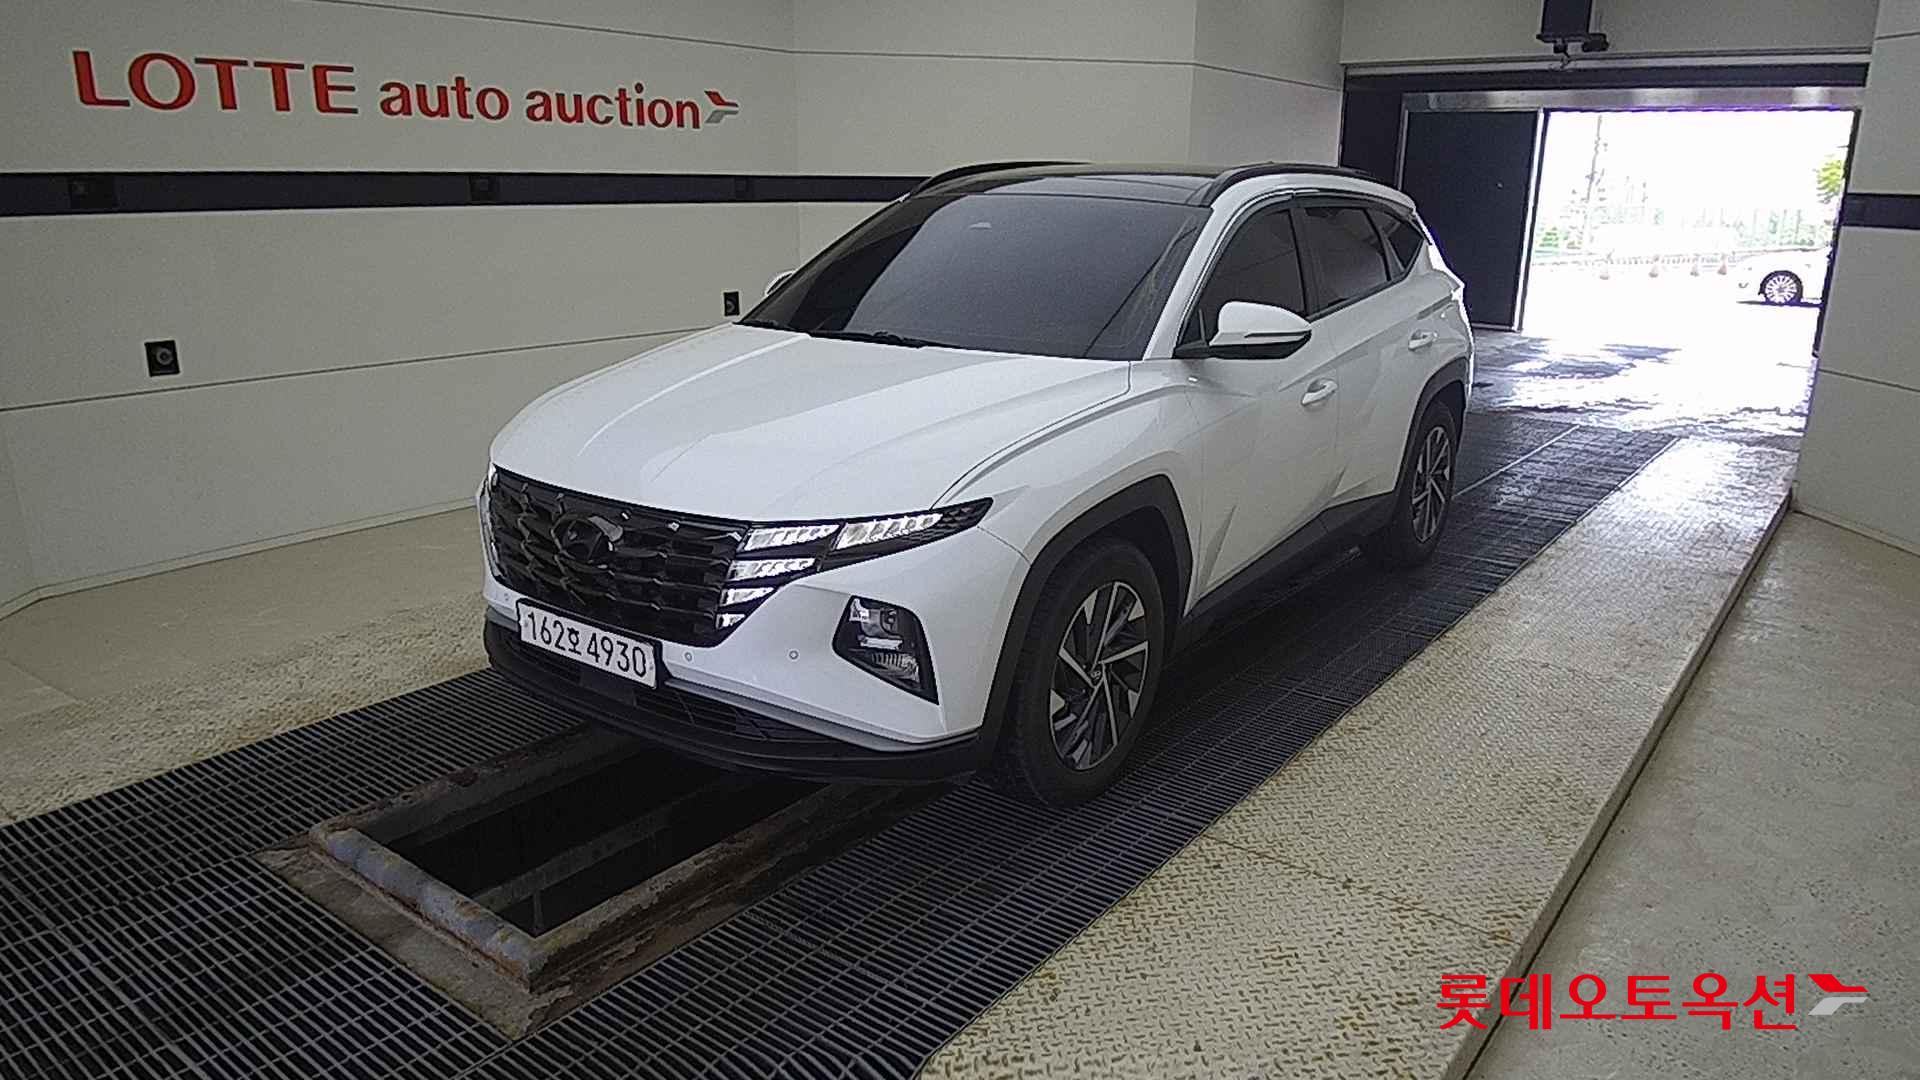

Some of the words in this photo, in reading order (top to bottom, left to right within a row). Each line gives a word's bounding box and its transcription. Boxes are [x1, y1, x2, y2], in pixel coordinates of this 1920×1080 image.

[73, 50, 359, 115] LOTTE
[379, 76, 509, 121] auto
[525, 82, 701, 130] auction
